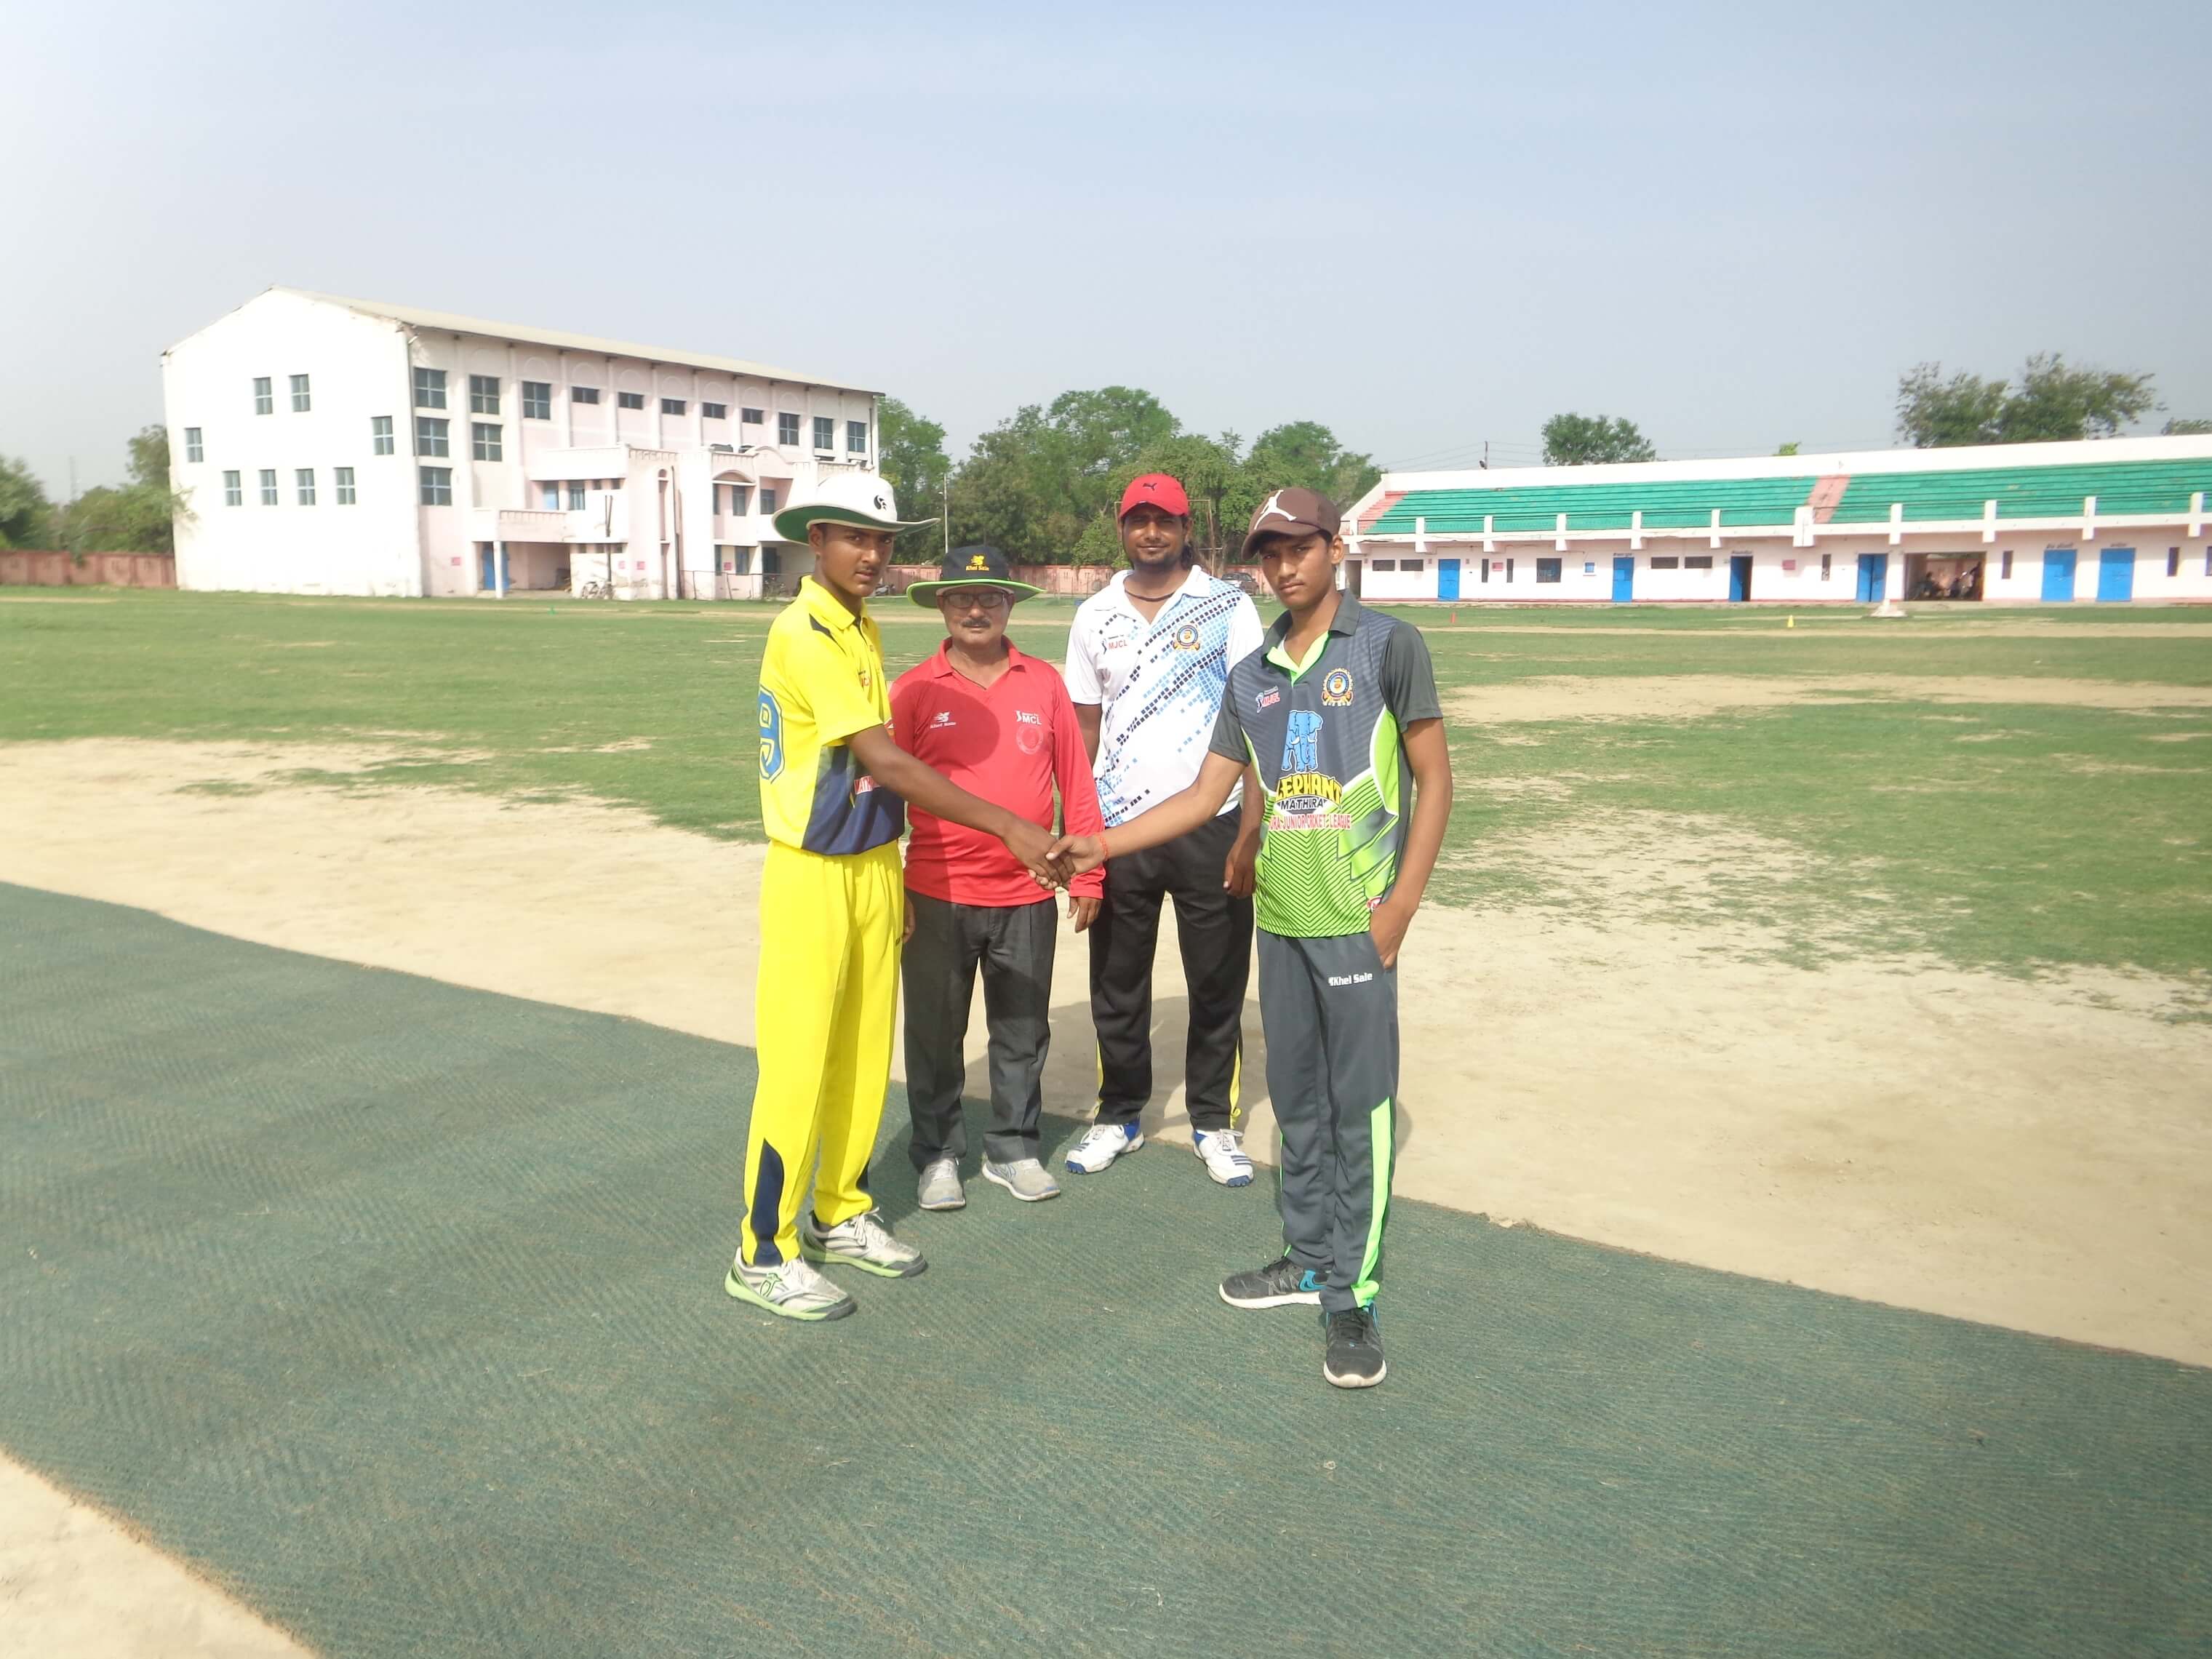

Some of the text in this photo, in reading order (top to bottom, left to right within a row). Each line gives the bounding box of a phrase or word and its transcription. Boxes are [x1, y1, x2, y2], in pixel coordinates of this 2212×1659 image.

[1109, 639, 1127, 649] MJCL
[1276, 772, 1342, 807] LEPHANT
[1353, 972, 1373, 983] Sale
